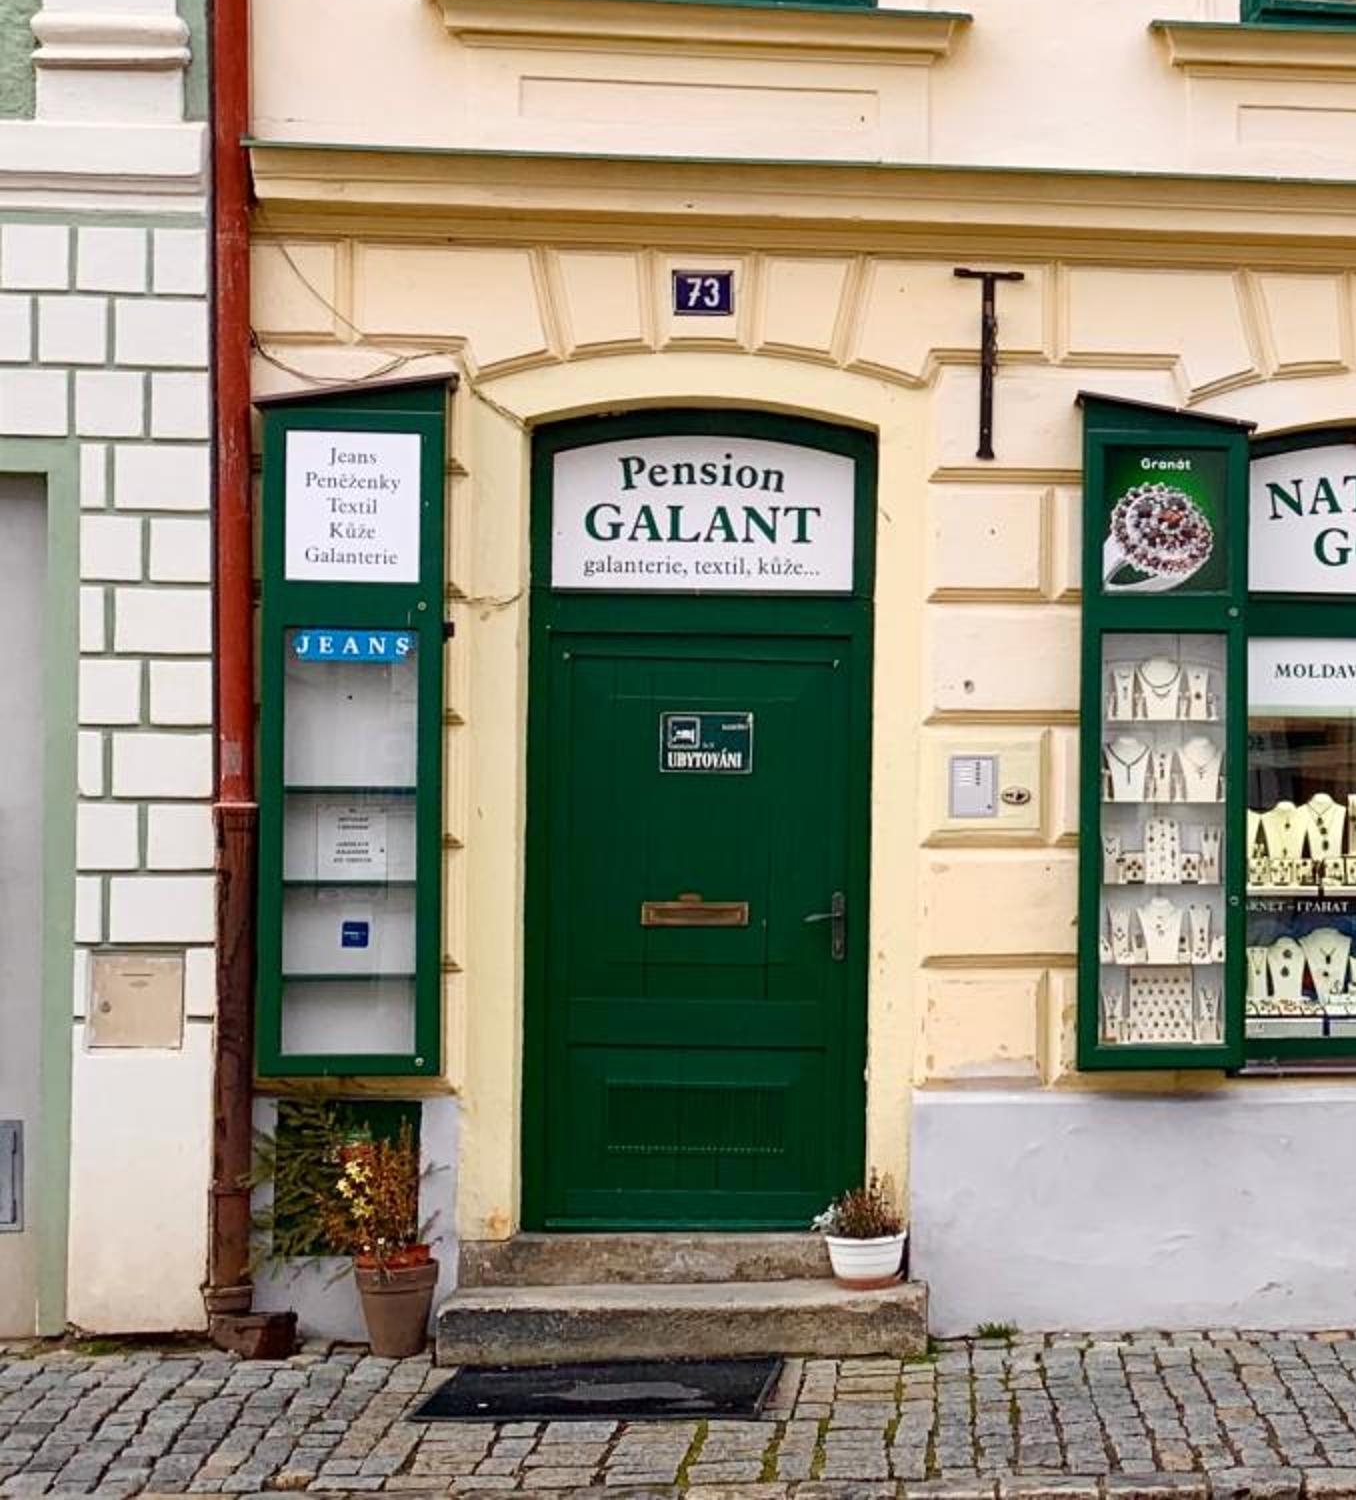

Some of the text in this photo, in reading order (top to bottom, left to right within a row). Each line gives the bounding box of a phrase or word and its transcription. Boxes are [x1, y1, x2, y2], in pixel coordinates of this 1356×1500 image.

[687, 278, 719, 307] 73
[329, 447, 377, 465] Jeans
[305, 471, 400, 493] Peněženky
[618, 453, 785, 493] Pension
[327, 497, 377, 514] Textil
[329, 521, 376, 540] Kůže
[584, 503, 821, 543] GALANT
[305, 546, 398, 565] Galanterie
[583, 555, 688, 577] galanterie,
[694, 555, 750, 575] textil,
[296, 635, 409, 655] JEANS
